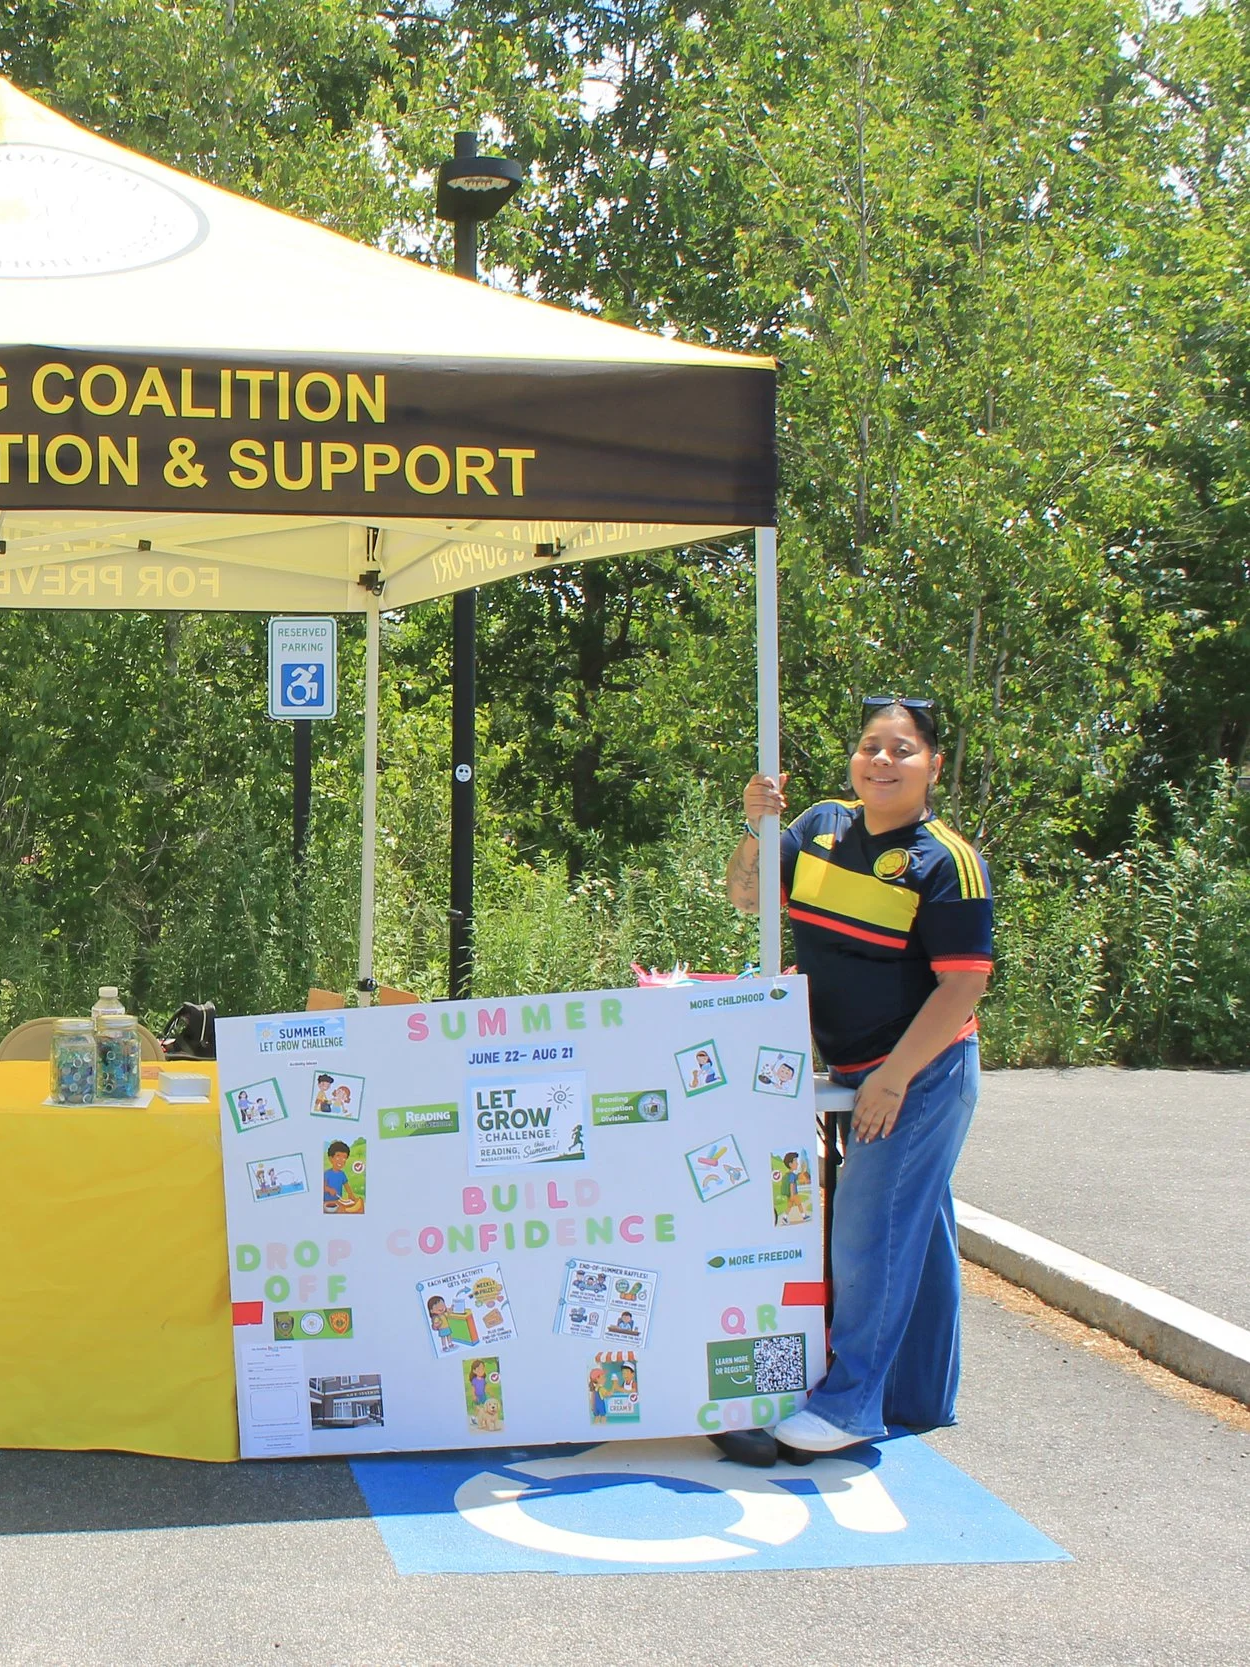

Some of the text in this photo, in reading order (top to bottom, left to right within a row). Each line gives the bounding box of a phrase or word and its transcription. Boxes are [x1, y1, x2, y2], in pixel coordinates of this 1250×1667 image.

[31, 363, 386, 423] COALITION
[163, 437, 208, 488] &
[228, 438, 535, 496] SUPPORT
[278, 628, 327, 637] RESERVED
[281, 643, 324, 652] PARKING
[690, 992, 765, 1010] MORE CHILDHOOD
[407, 998, 623, 1042] SUMMER
[279, 1026, 326, 1039] SUMMER
[259, 1037, 343, 1052] LET GROW CHALLENGE
[468, 1052, 500, 1065] JUNE
[532, 1049, 557, 1060] AUG
[562, 1047, 573, 1058] 21
[476, 1089, 516, 1110] LET
[477, 1107, 551, 1131] GROW
[485, 1129, 551, 1142] CHALLENGE
[462, 1178, 600, 1215] BUILD
[386, 1213, 676, 1256] CONFIDENCE
[236, 1239, 351, 1272] DROP
[729, 1249, 803, 1266] MORE FREEDOM
[579, 1263, 623, 1275] END-OF-SUMMER
[264, 1275, 348, 1303] OFF
[427, 1279, 441, 1288] EACH
[721, 1304, 778, 1335] QR
[715, 1355, 749, 1366] LEARN MORE
[697, 1395, 795, 1430] CODE
